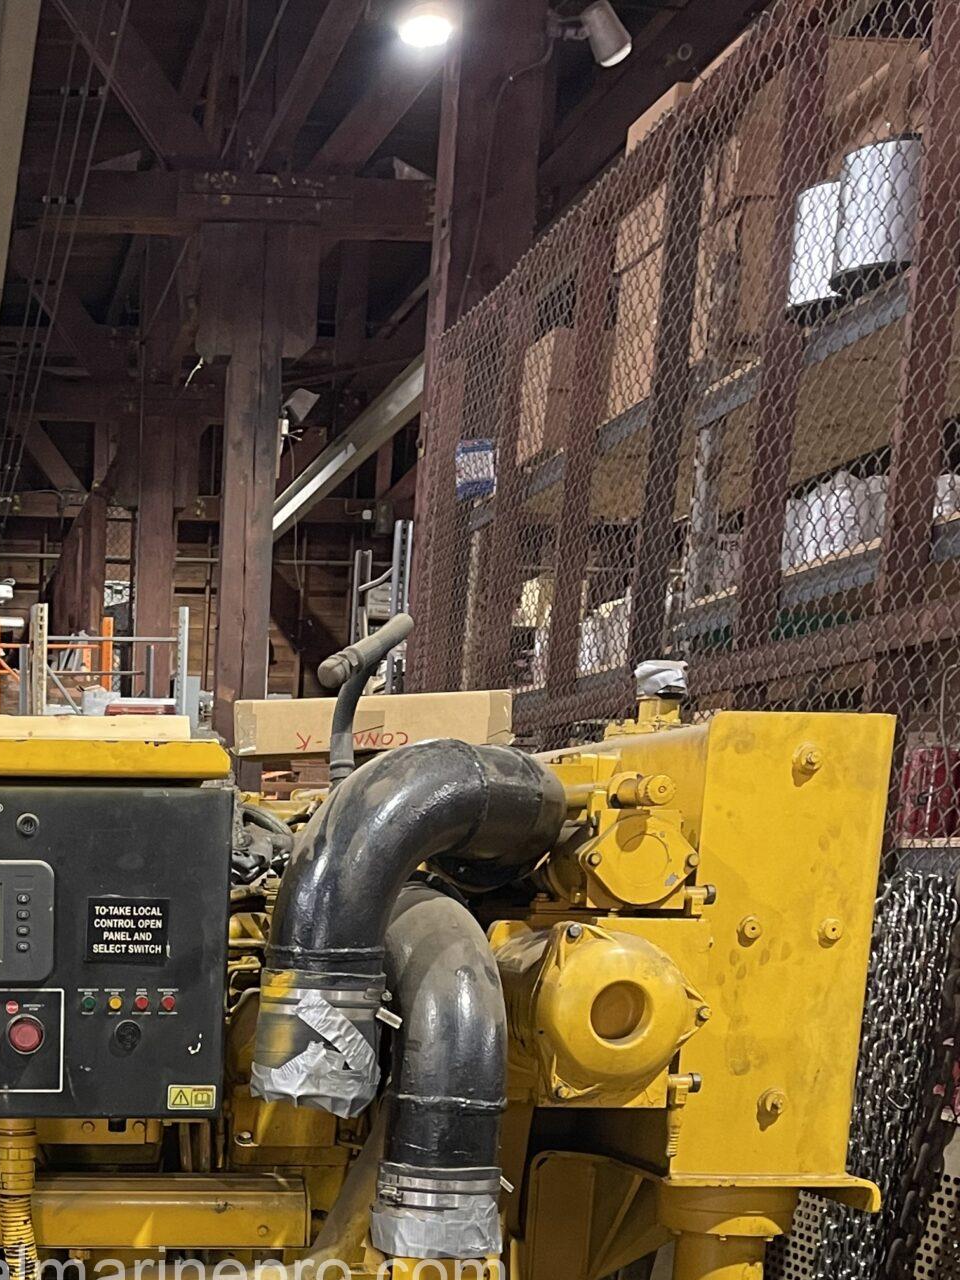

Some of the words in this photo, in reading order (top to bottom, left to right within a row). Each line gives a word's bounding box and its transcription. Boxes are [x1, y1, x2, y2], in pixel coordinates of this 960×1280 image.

[133, 906, 162, 917] LOCAL
[93, 918, 136, 929] CONTROL
[137, 919, 162, 929] OPEN
[103, 931, 132, 941] PANEL
[133, 931, 152, 941] AND
[92, 943, 127, 954] SELECT
[127, 944, 162, 954] SWITCH
